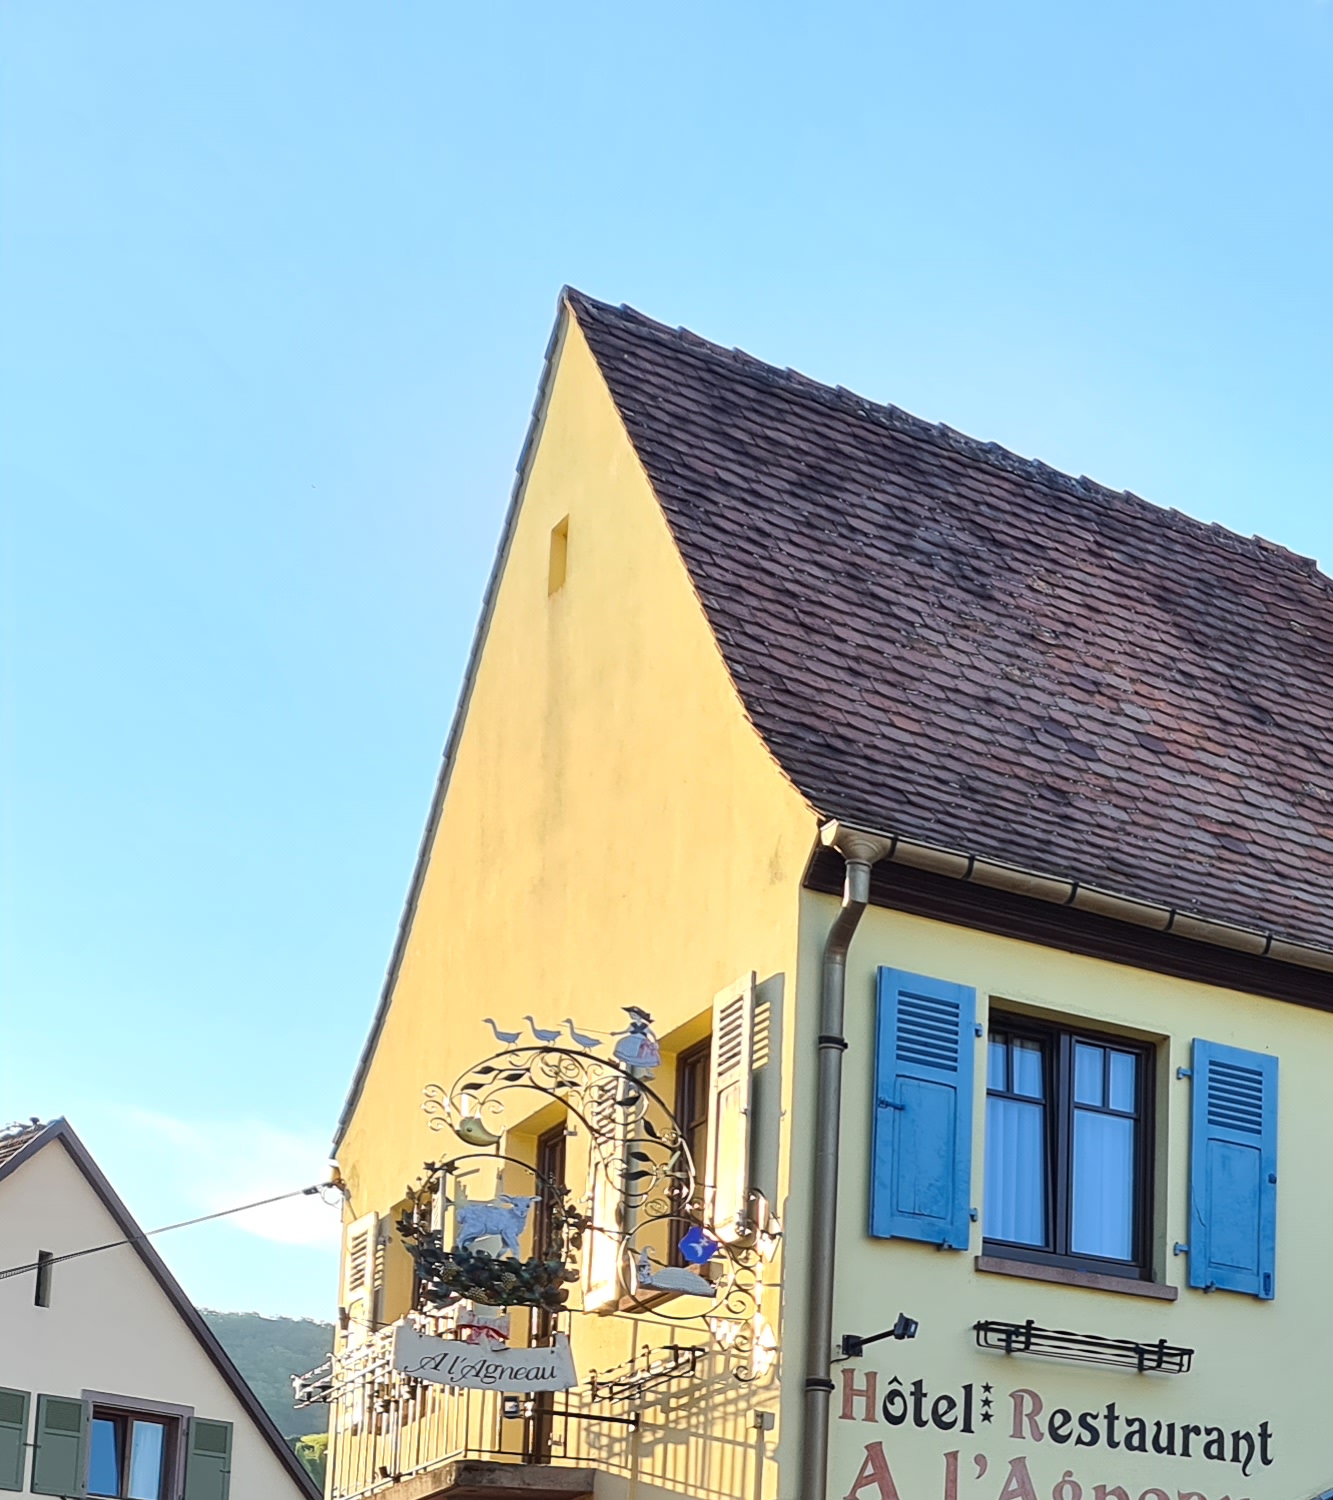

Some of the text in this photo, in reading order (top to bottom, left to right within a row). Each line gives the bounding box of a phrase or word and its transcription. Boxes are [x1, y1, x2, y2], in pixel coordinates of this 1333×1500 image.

[404, 1352, 557, 1385] A l'Agneau
[838, 1367, 1274, 1477] Hôtel Restaurant
